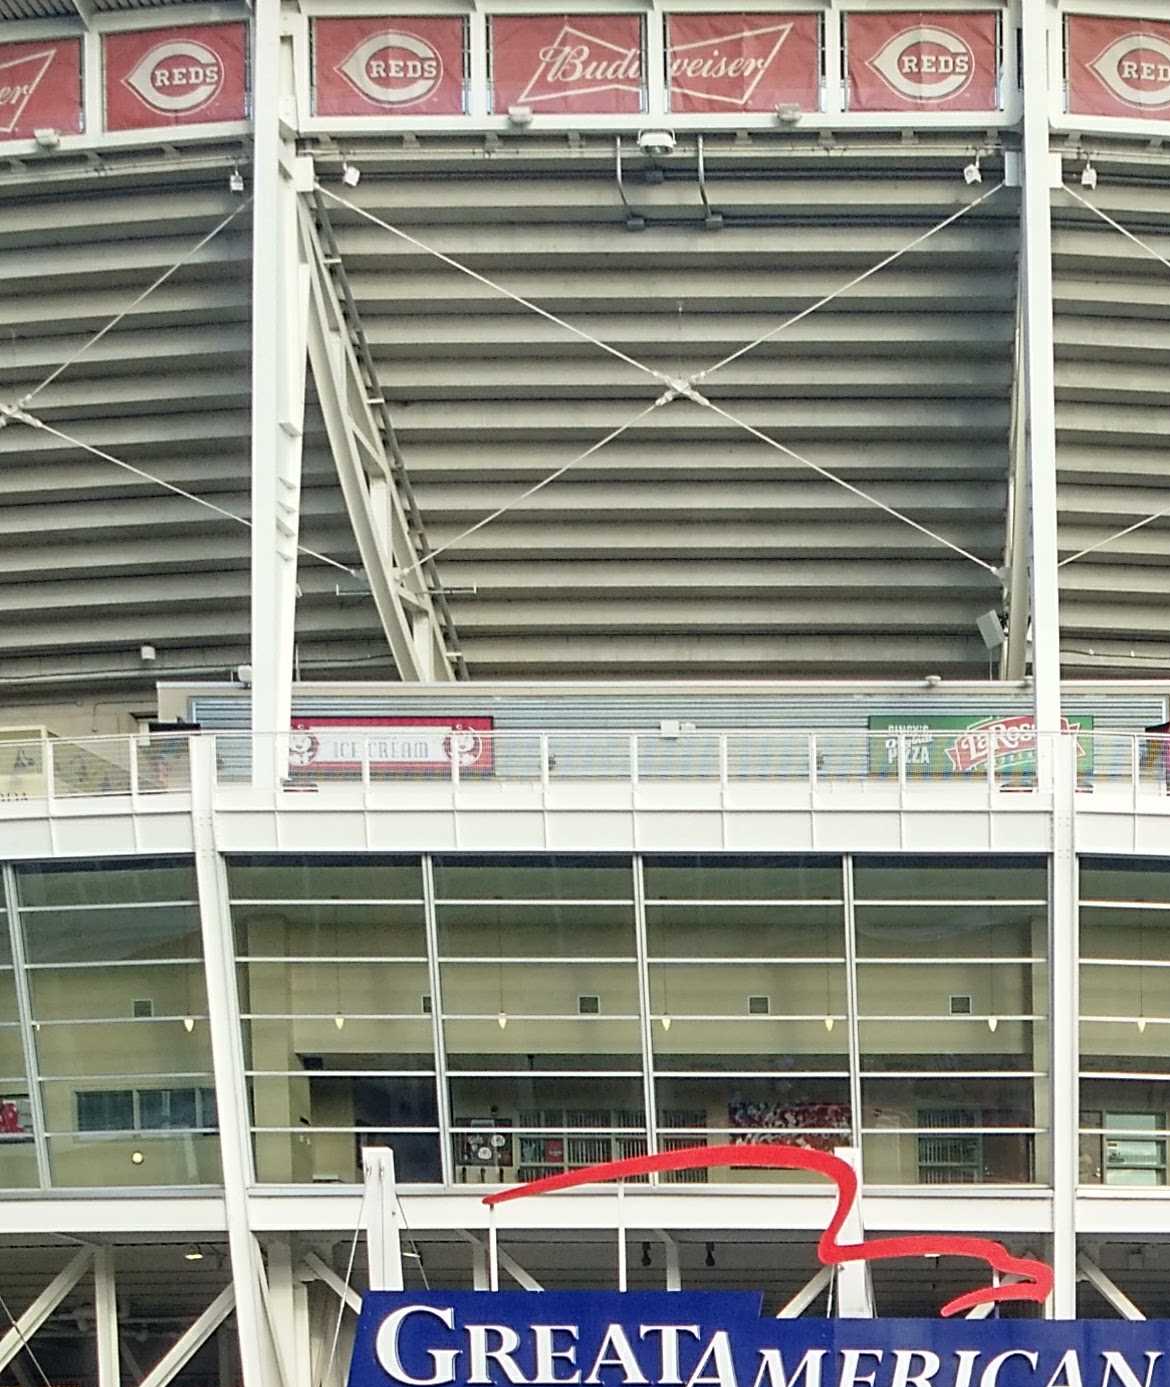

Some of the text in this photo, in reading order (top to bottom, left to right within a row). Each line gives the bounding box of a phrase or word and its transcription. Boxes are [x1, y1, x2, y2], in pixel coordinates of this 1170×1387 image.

[370, 60, 437, 79] REDS
[901, 55, 969, 74] REDS
[154, 67, 219, 87] REDS
[368, 740, 429, 759] CREAM
[375, 1304, 701, 1387] GREAT
